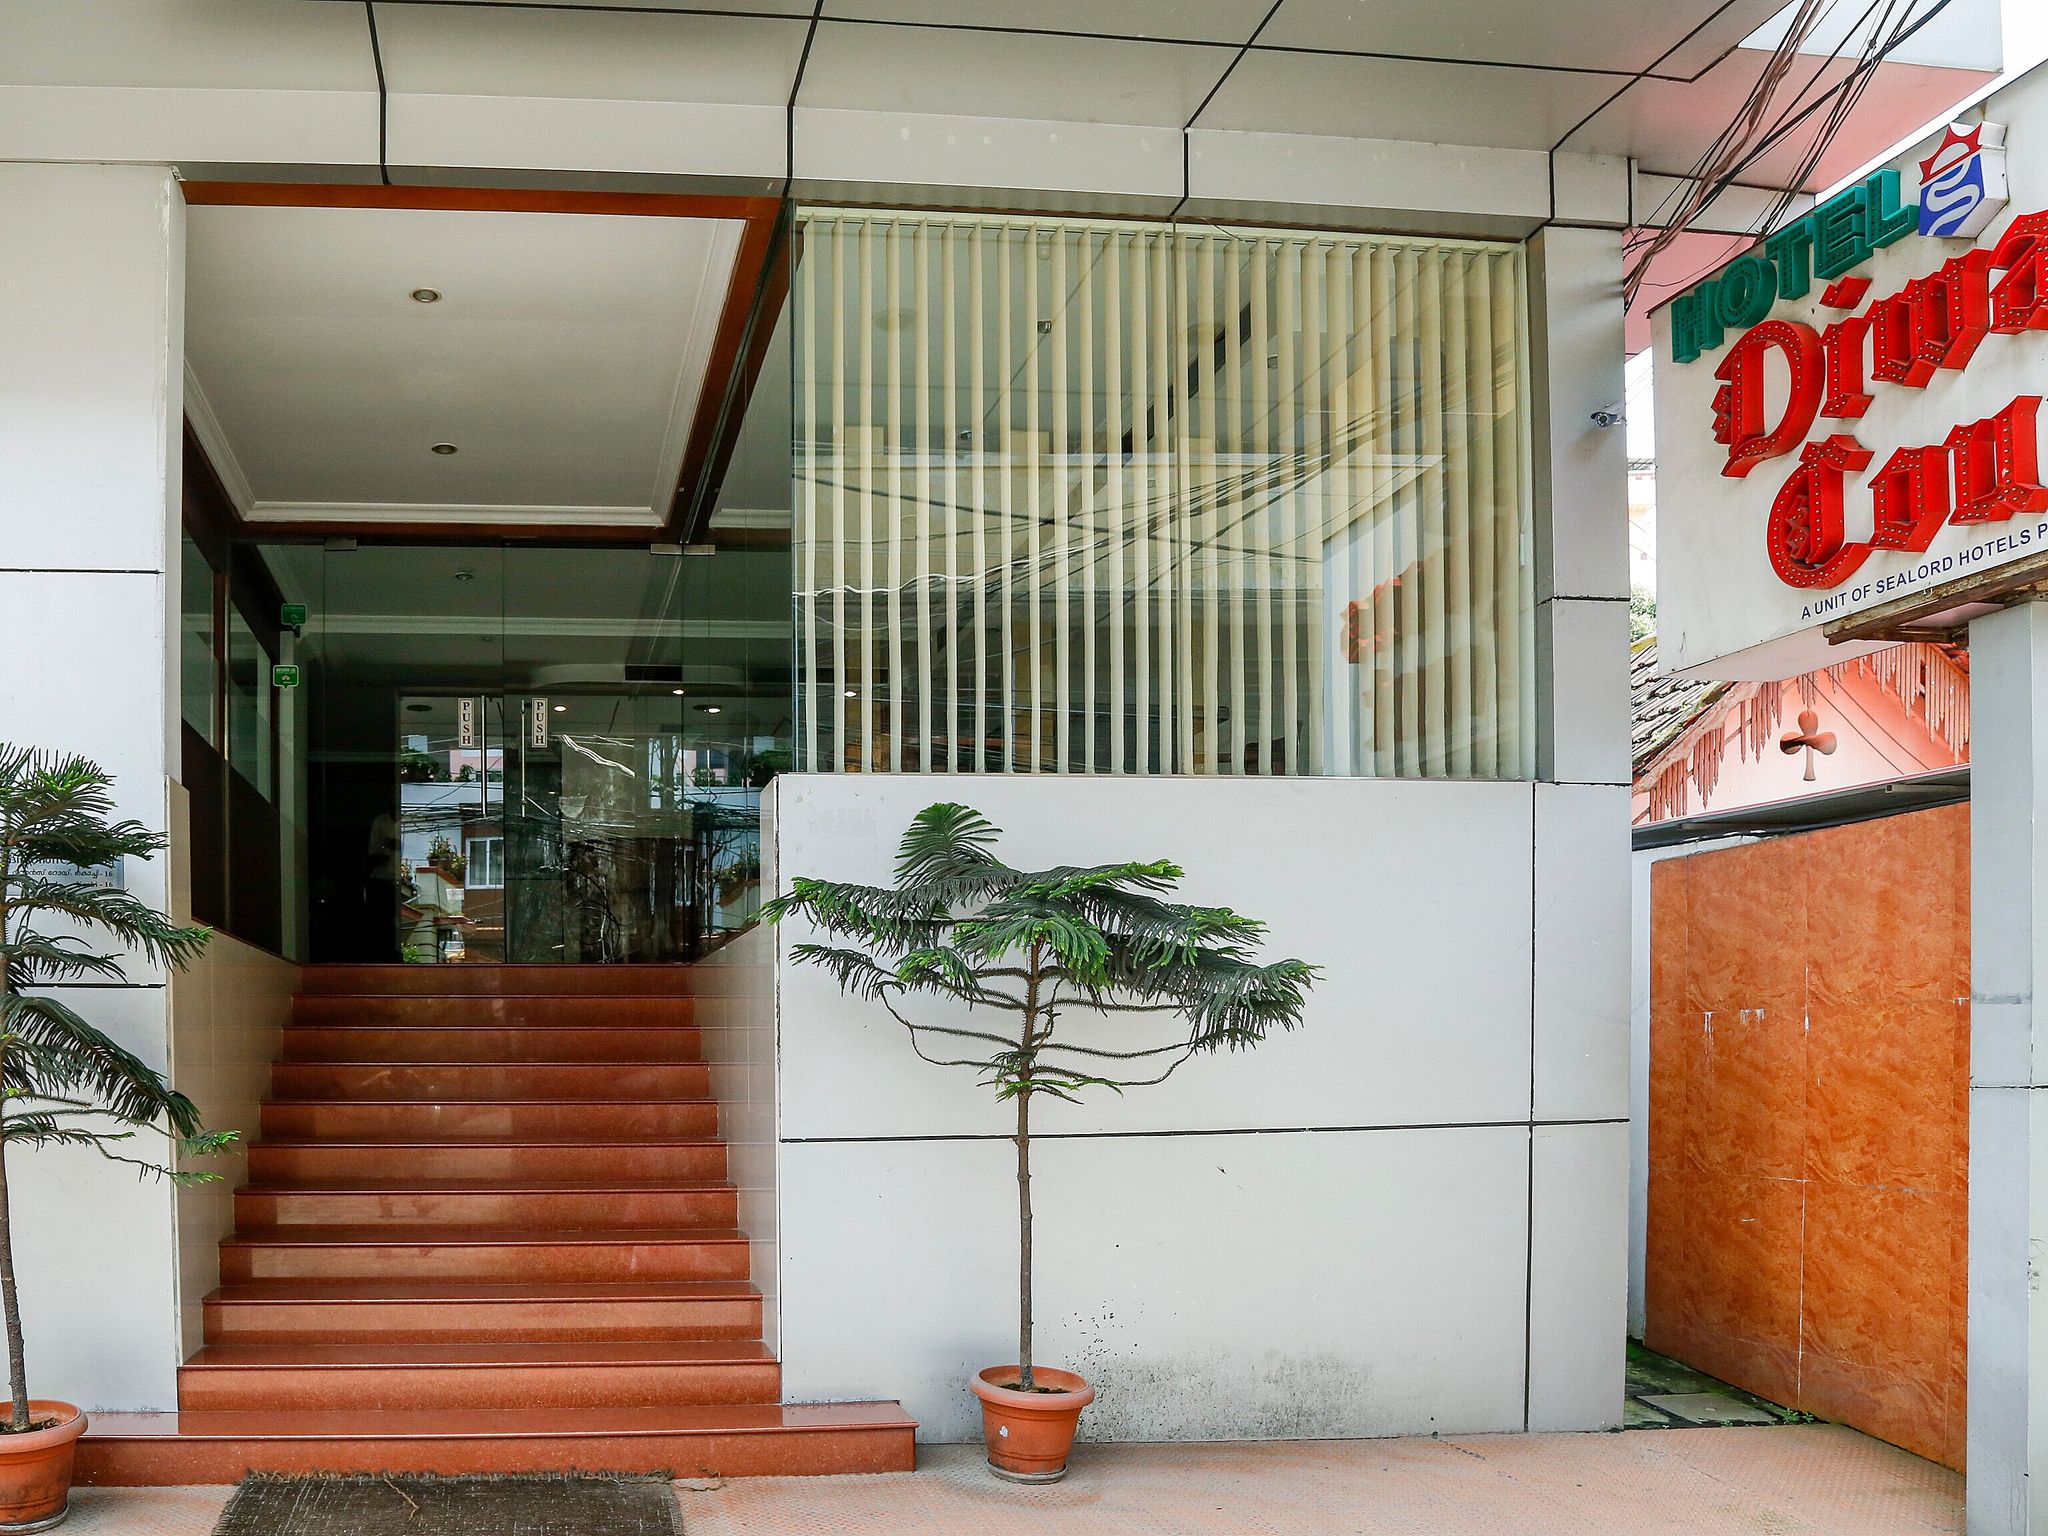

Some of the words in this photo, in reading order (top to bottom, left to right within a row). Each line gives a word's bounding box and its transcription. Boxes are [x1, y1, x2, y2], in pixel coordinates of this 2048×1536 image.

[1671, 168, 1919, 364] HOTEL
[1801, 605, 1812, 620] A
[1814, 592, 1847, 615] UNIT
[1851, 583, 1872, 602] OF
[1876, 556, 1953, 595] SEALORD
[1958, 528, 2032, 566] HOTELS
[462, 702, 471, 745] PUSH
[535, 702, 545, 745] PUSH
